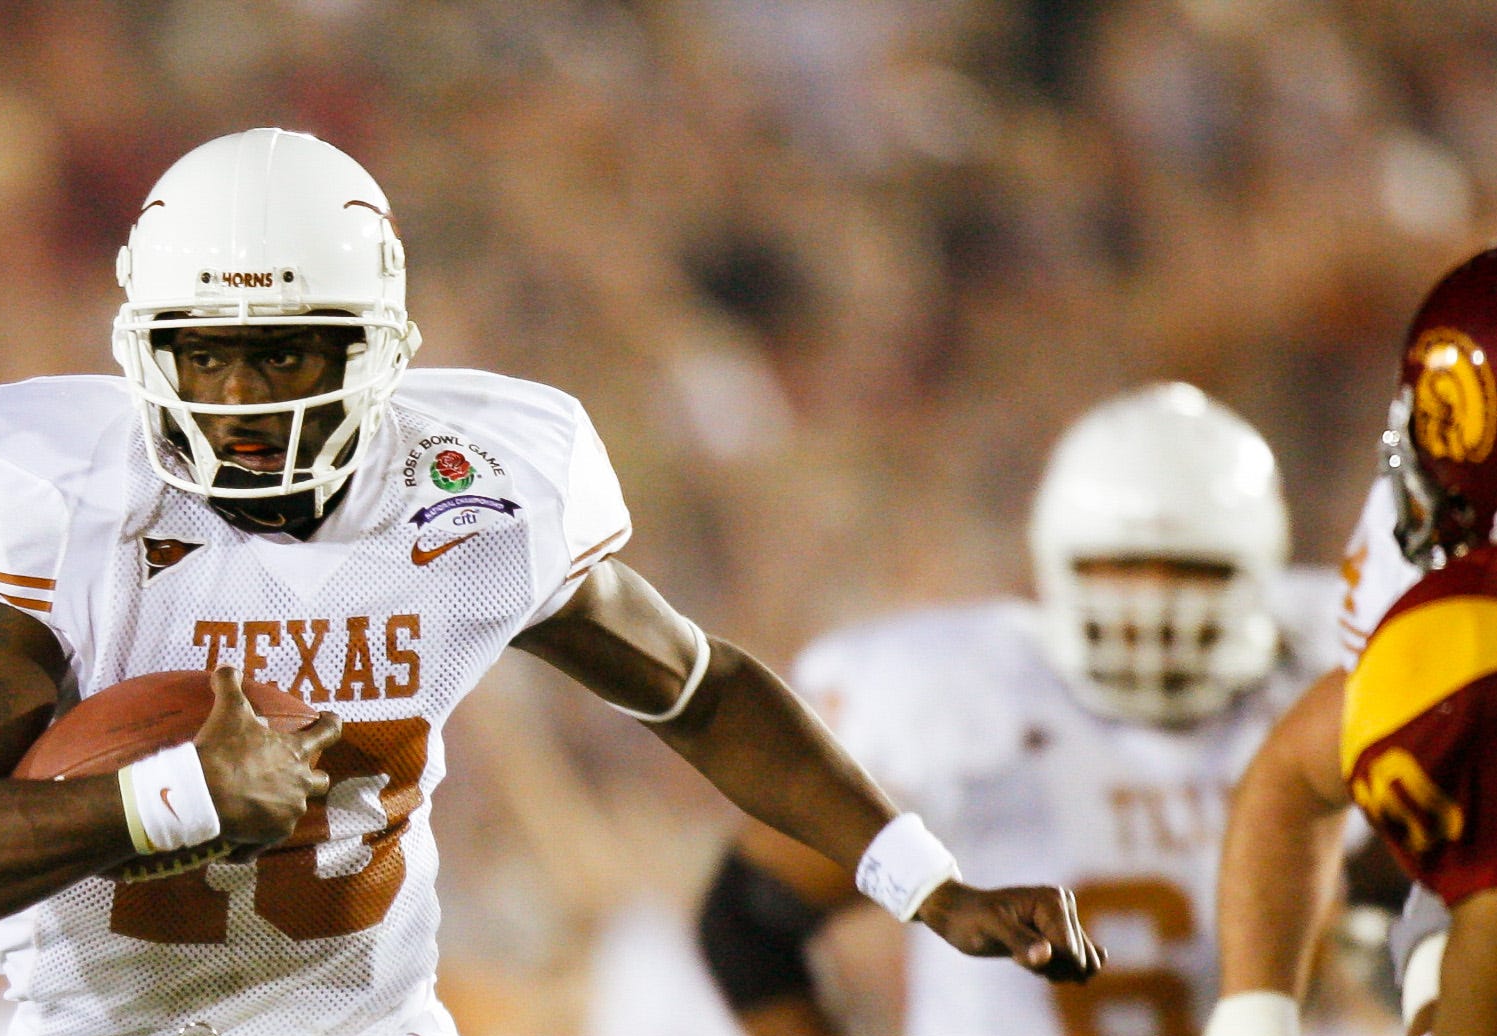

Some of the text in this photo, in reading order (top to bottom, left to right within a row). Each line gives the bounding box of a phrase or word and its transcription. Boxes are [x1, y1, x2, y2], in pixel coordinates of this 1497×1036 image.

[222, 272, 273, 288] HORNS
[403, 435, 506, 488] ROSE BOWL GAME
[452, 510, 478, 526] citi
[192, 614, 422, 704] TEXAS
